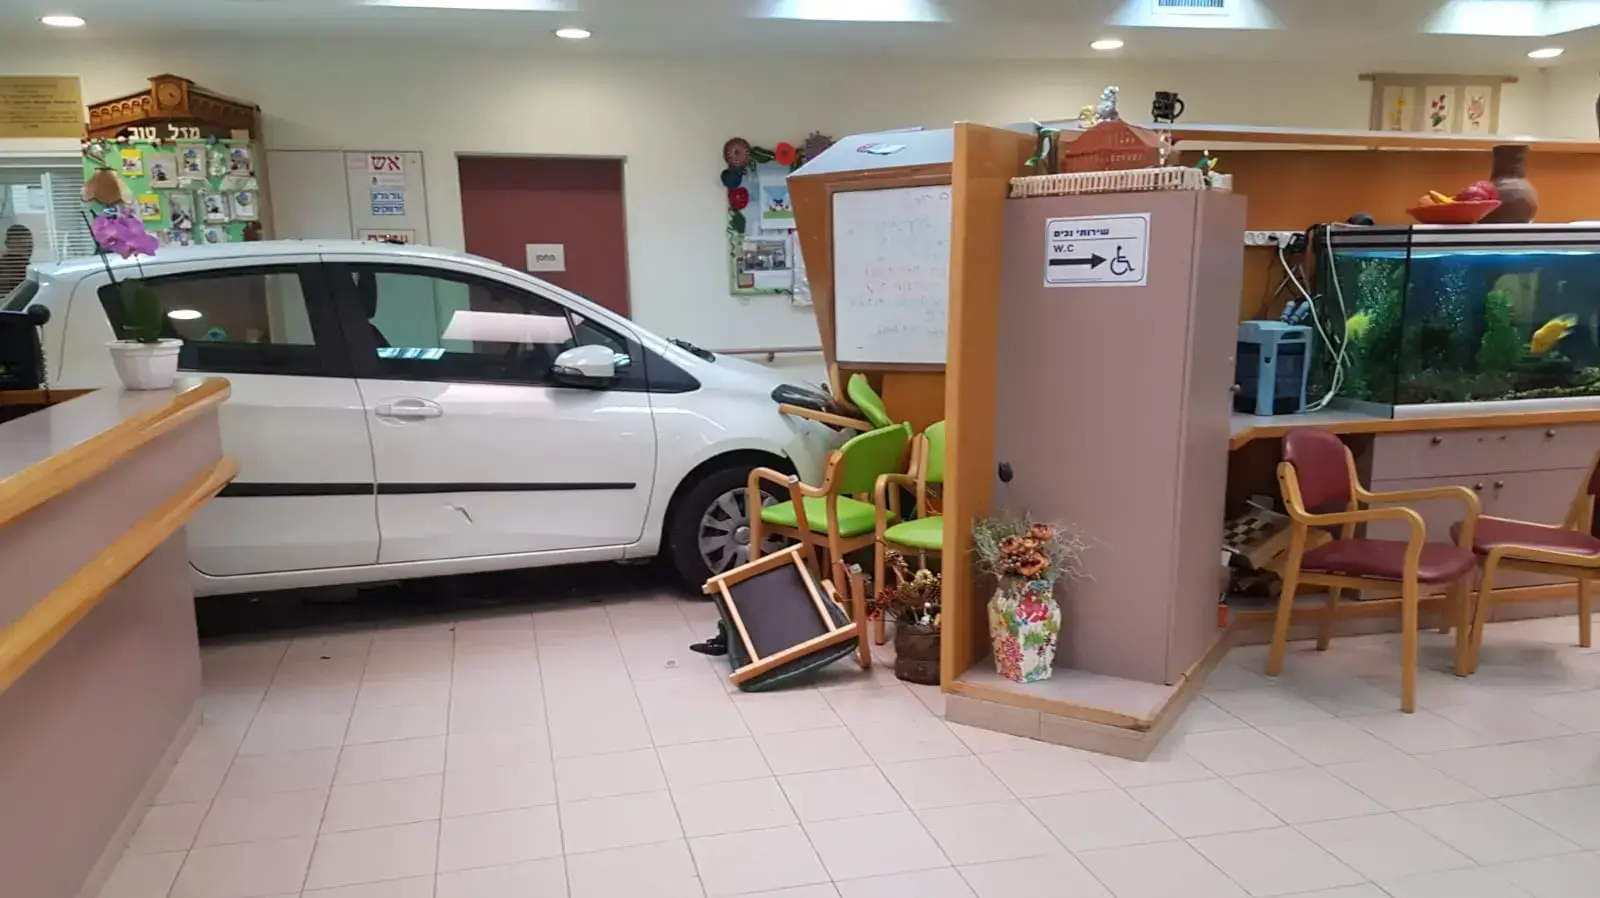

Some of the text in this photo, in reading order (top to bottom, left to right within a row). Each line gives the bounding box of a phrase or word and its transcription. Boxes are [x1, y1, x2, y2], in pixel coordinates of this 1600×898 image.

[127, 123, 201, 141] מזל טוב
[371, 155, 401, 171] אש
[1053, 228, 1110, 238] שירותי נכים
[1053, 244, 1075, 253] W.C
